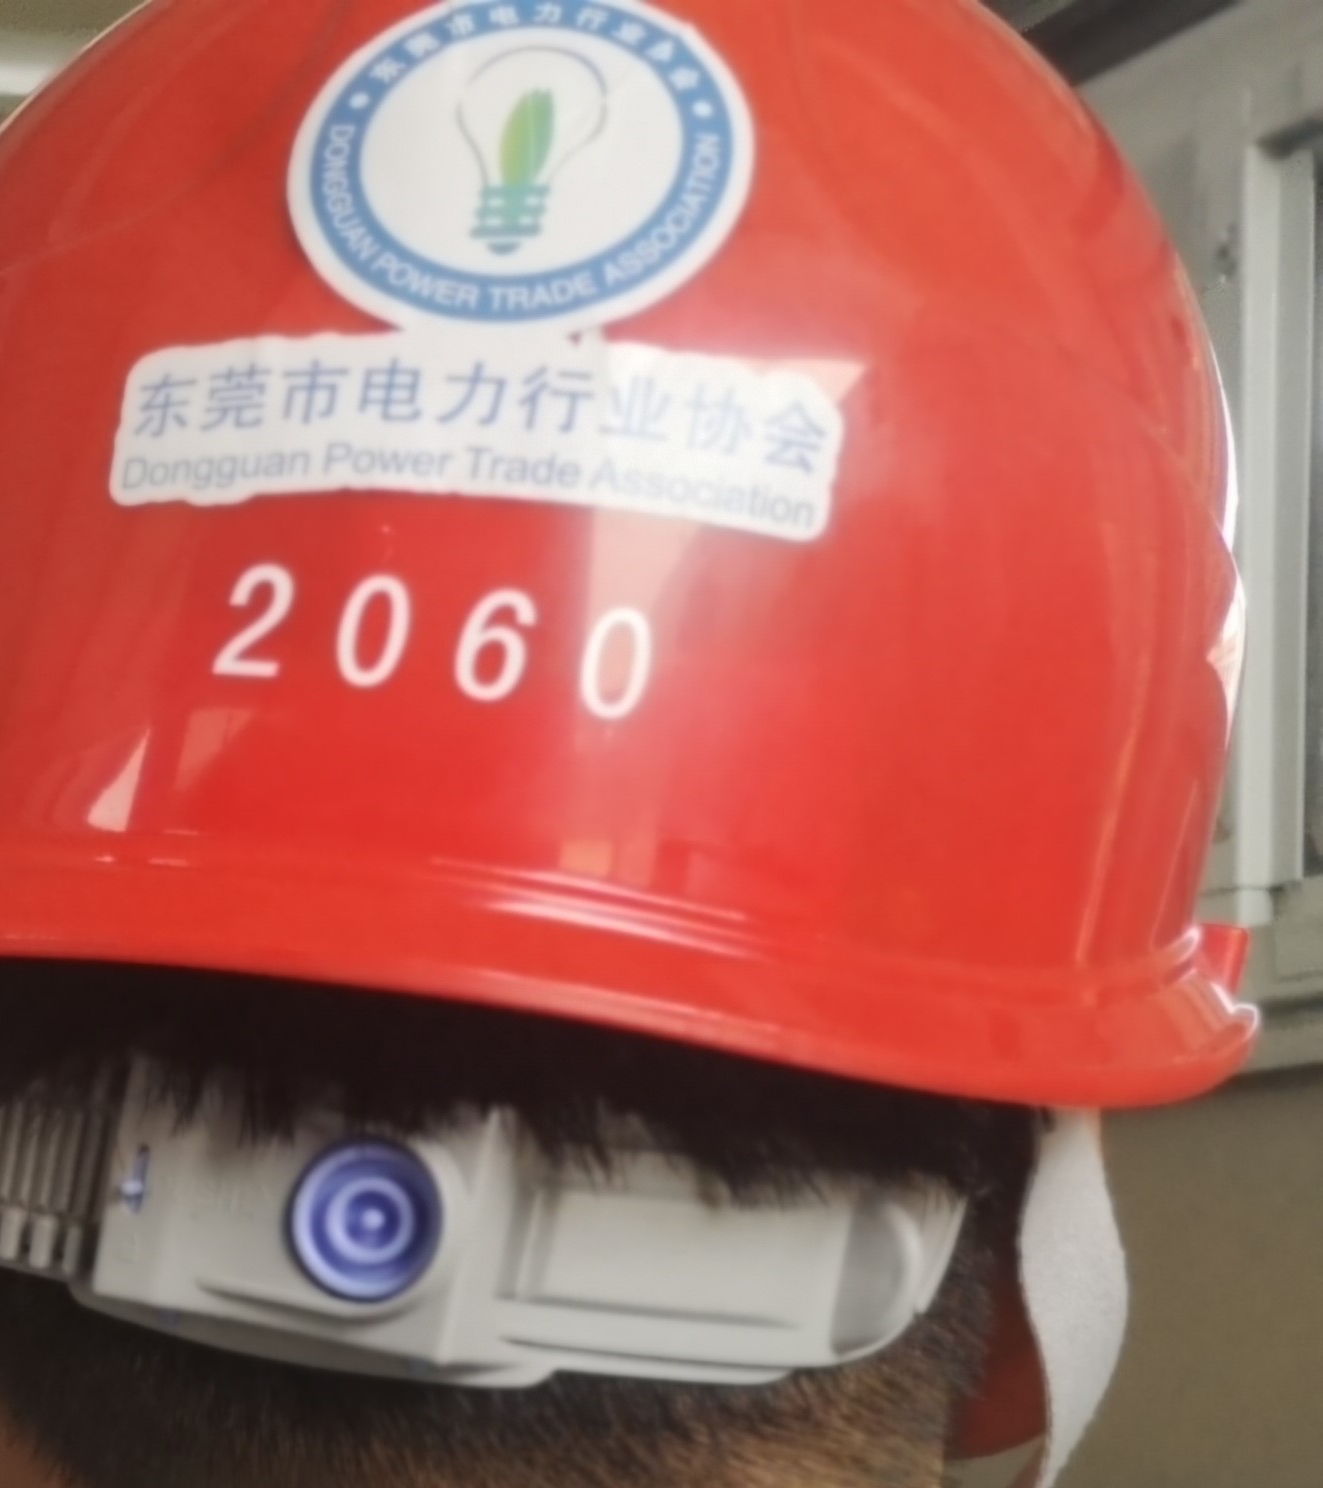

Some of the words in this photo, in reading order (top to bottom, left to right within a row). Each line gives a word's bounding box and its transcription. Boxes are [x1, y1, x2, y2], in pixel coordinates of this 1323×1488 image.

[323, 123, 381, 261] DONGGUAN
[371, 251, 479, 309] POWER
[486, 271, 598, 311] TRADE
[604, 134, 721, 286] ASSOCIATION
[120, 448, 312, 491] Dongguan
[321, 441, 455, 479] Power
[464, 445, 583, 488] Trade
[587, 457, 816, 526] Association
[133, 357, 828, 474] 东莞市电力行业协会
[212, 563, 652, 720] 2060
